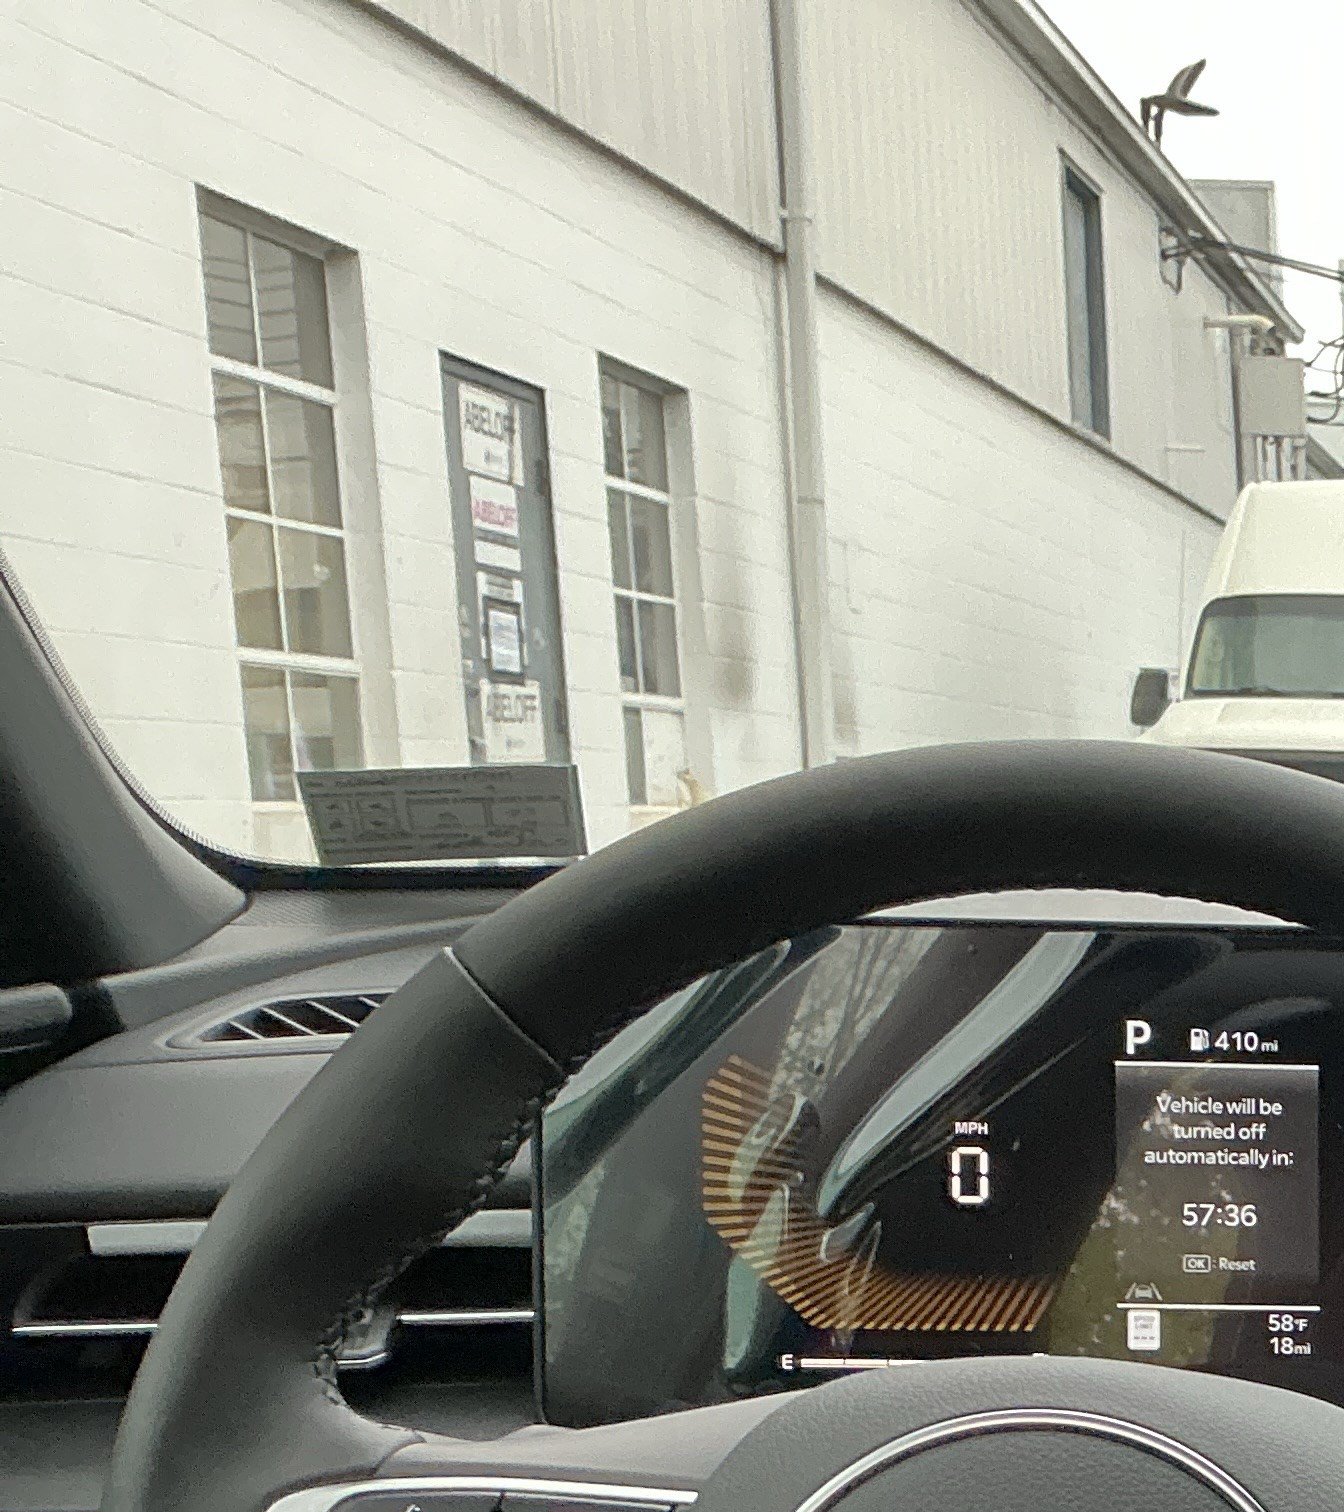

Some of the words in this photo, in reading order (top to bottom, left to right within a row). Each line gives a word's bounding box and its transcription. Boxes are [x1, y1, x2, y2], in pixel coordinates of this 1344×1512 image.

[1126, 1020, 1151, 1055] P
[1156, 1095, 1223, 1114] Vehicle
[1225, 1097, 1256, 1115] will
[1259, 1098, 1283, 1115] be
[954, 1121, 989, 1135] MPH
[1173, 1122, 1235, 1140] turned
[1238, 1123, 1267, 1140] off
[1144, 1147, 1270, 1169] automatically
[1272, 1148, 1294, 1166] in:
[951, 1146, 989, 1204] 0
[1181, 1203, 1258, 1227] 57:36
[1187, 1259, 1205, 1269] OK
[781, 1354, 794, 1370] E
